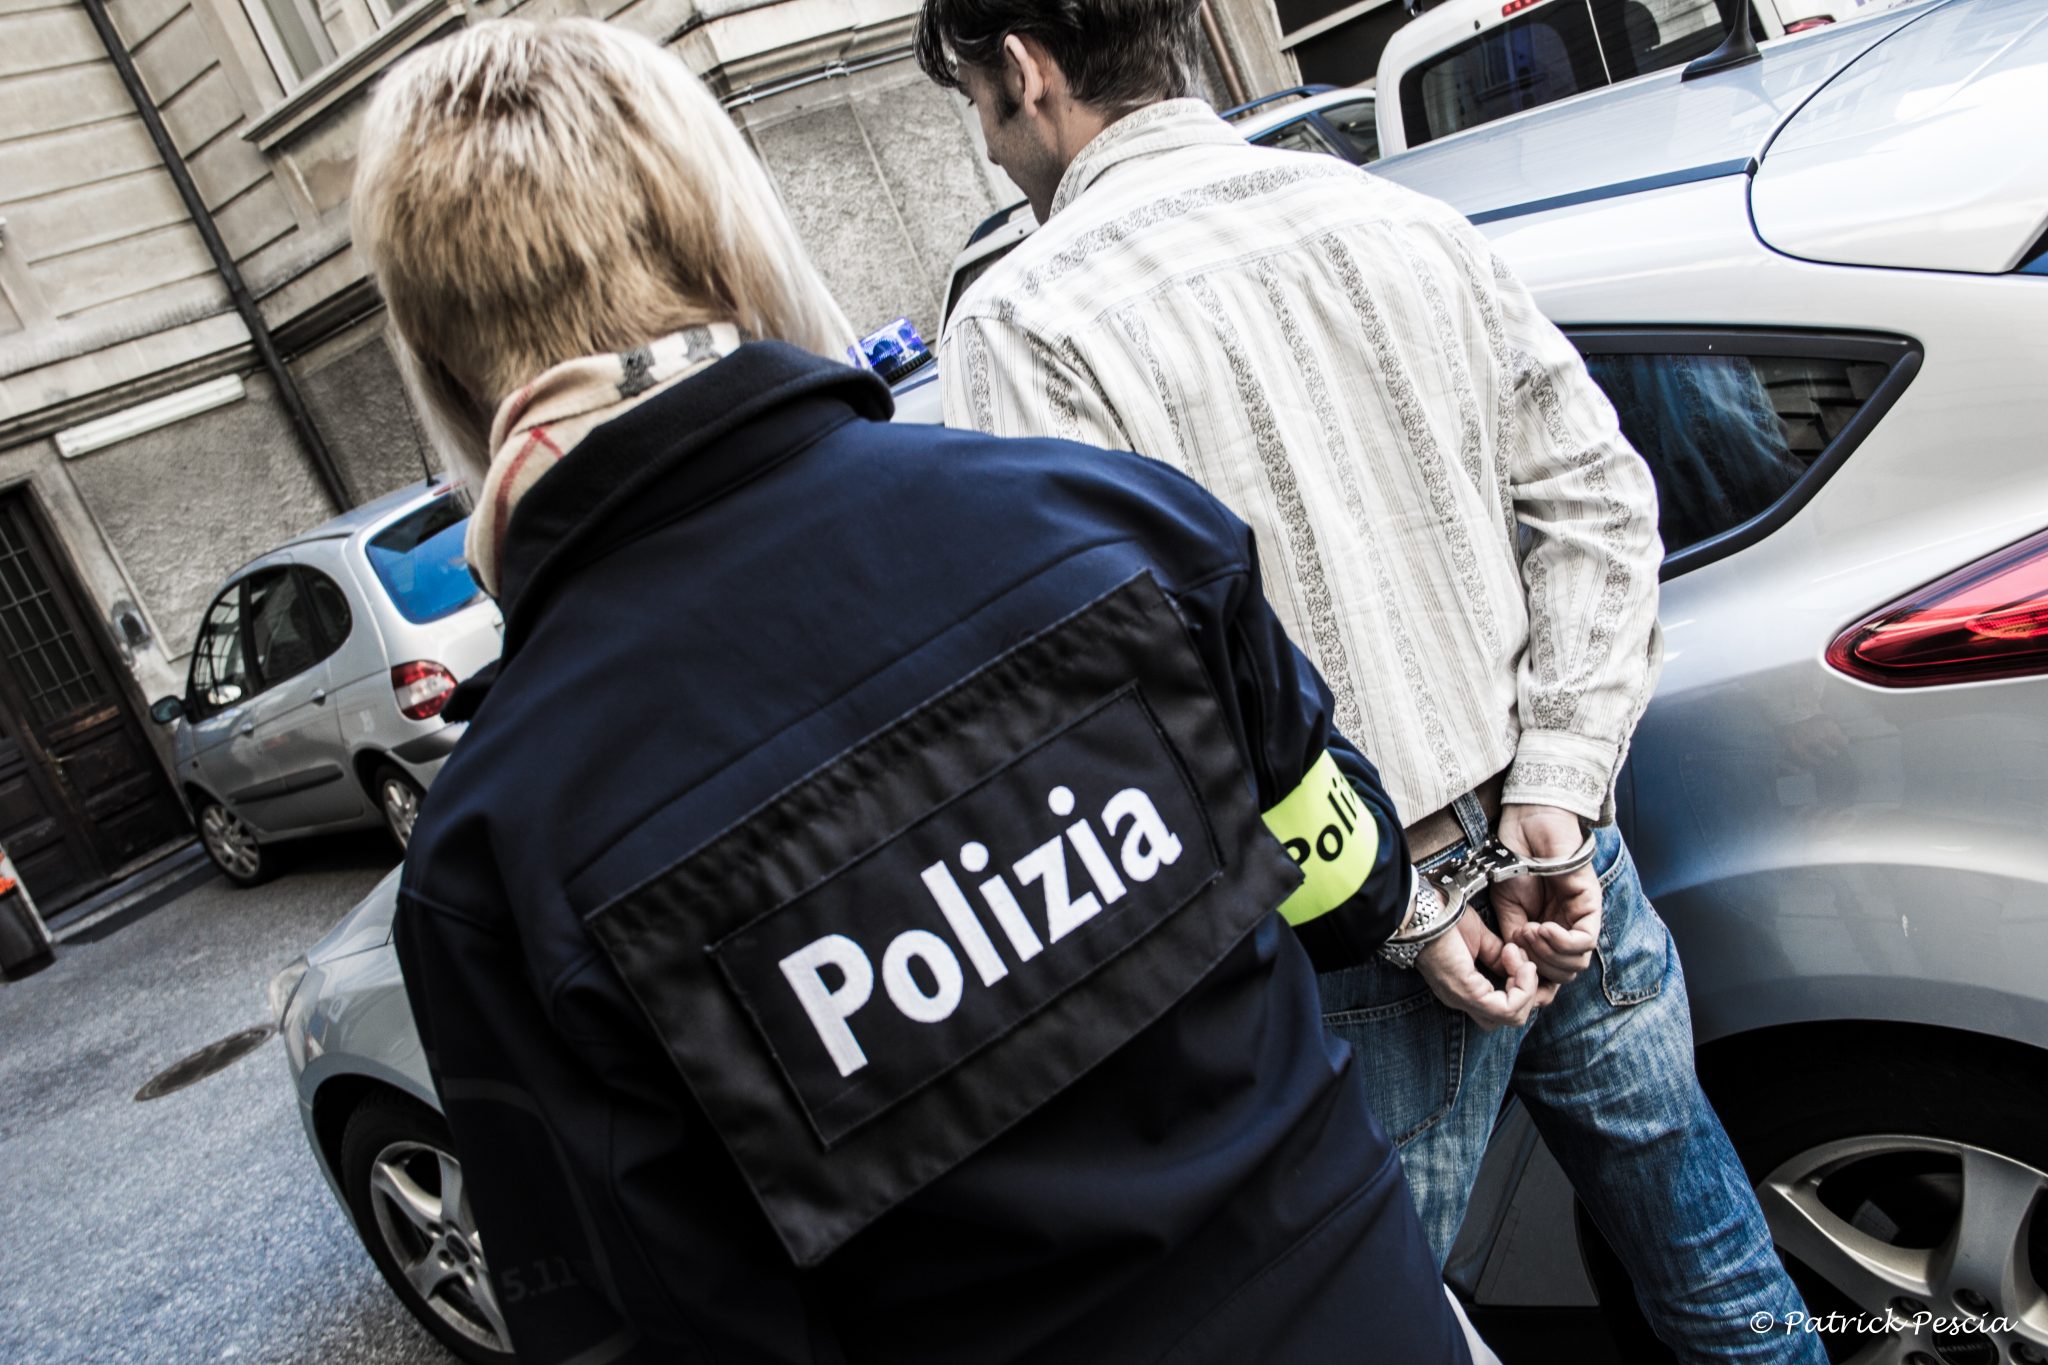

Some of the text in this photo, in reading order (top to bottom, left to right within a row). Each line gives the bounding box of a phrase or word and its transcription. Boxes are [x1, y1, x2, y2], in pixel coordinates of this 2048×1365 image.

[1282, 776, 1357, 863] Poli
[779, 786, 1182, 1077] Polizia
[500, 1255, 579, 1302] 5.11
